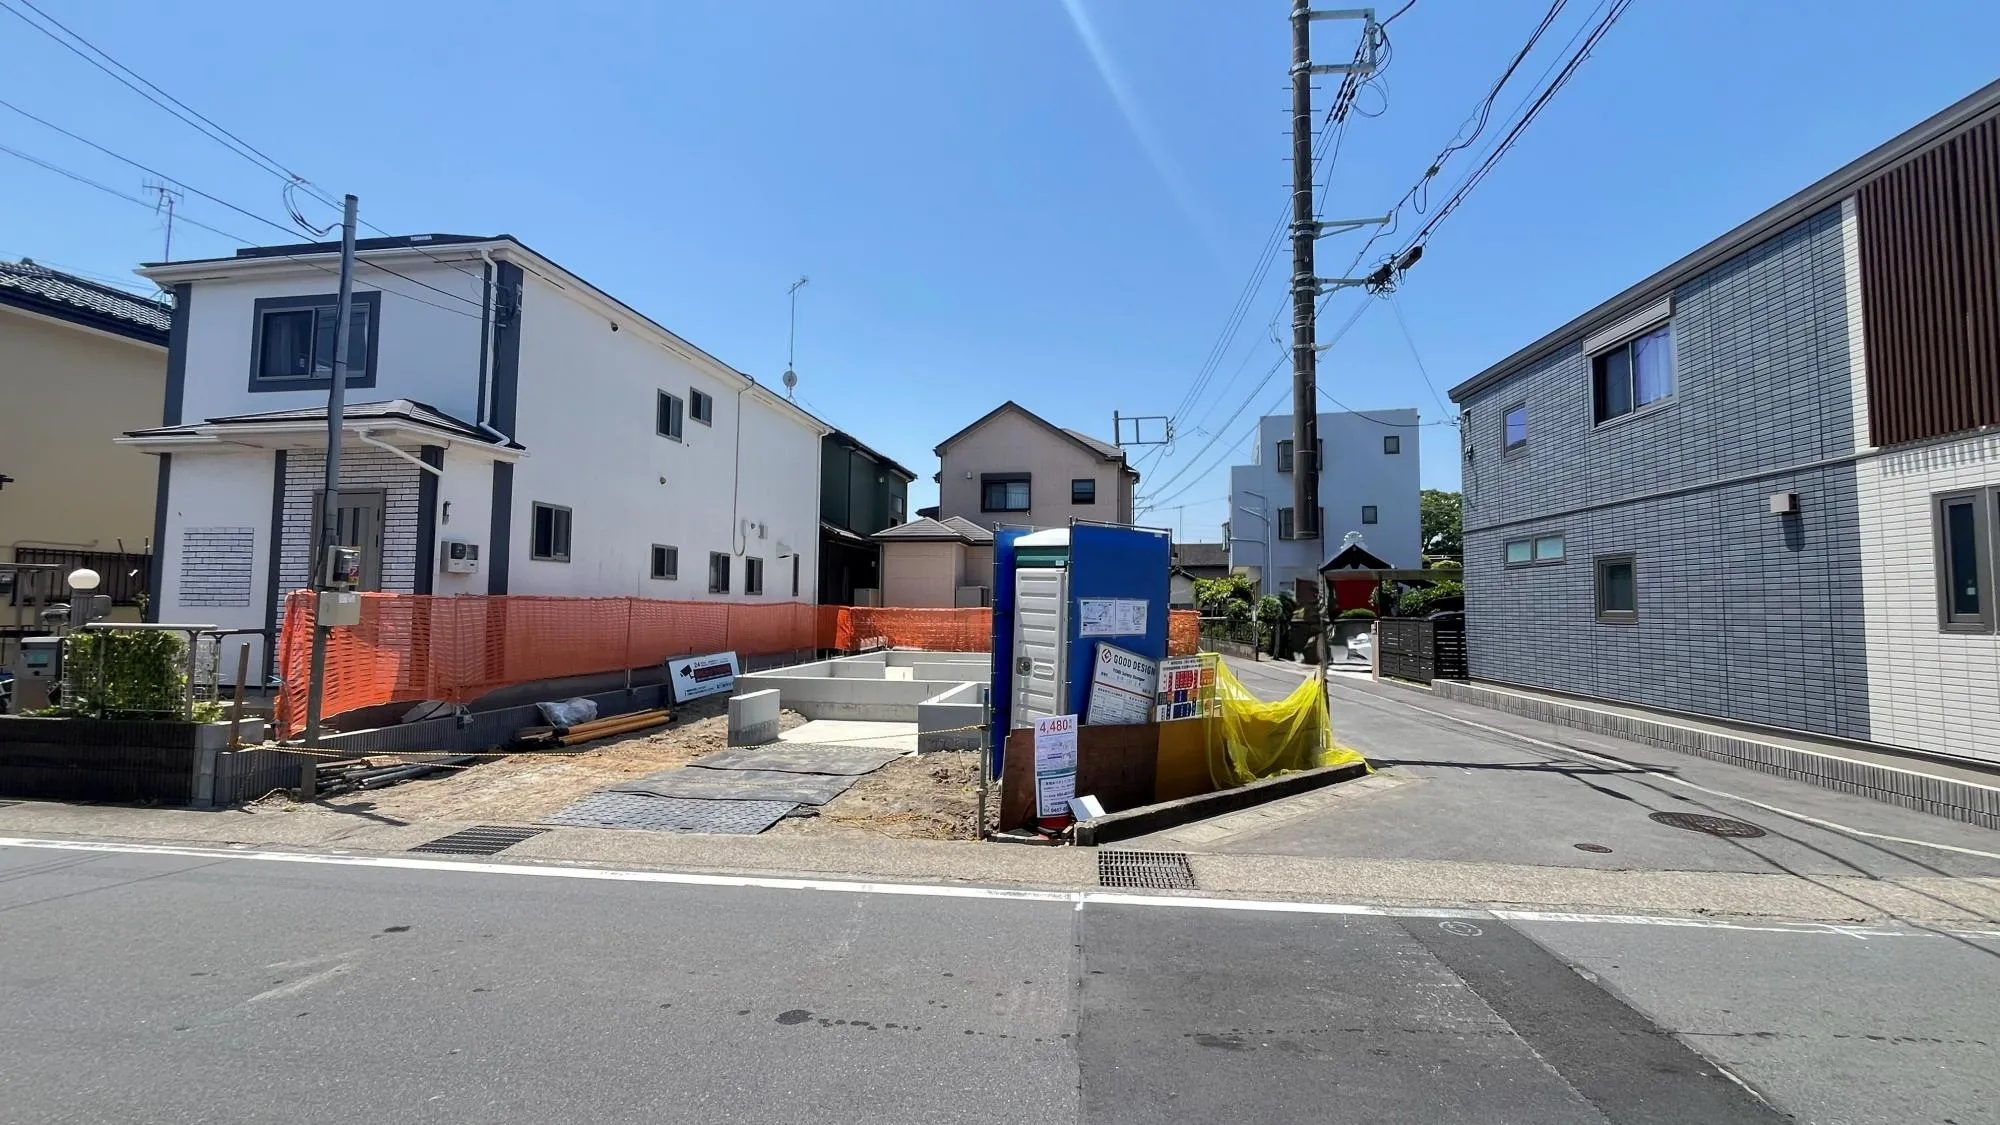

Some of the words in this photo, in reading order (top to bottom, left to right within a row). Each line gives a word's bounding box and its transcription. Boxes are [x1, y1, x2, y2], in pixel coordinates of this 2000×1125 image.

[1113, 654, 1132, 668] GOOD
[1133, 661, 1156, 676] DESIGN
[1039, 719, 1068, 734] 4,480
